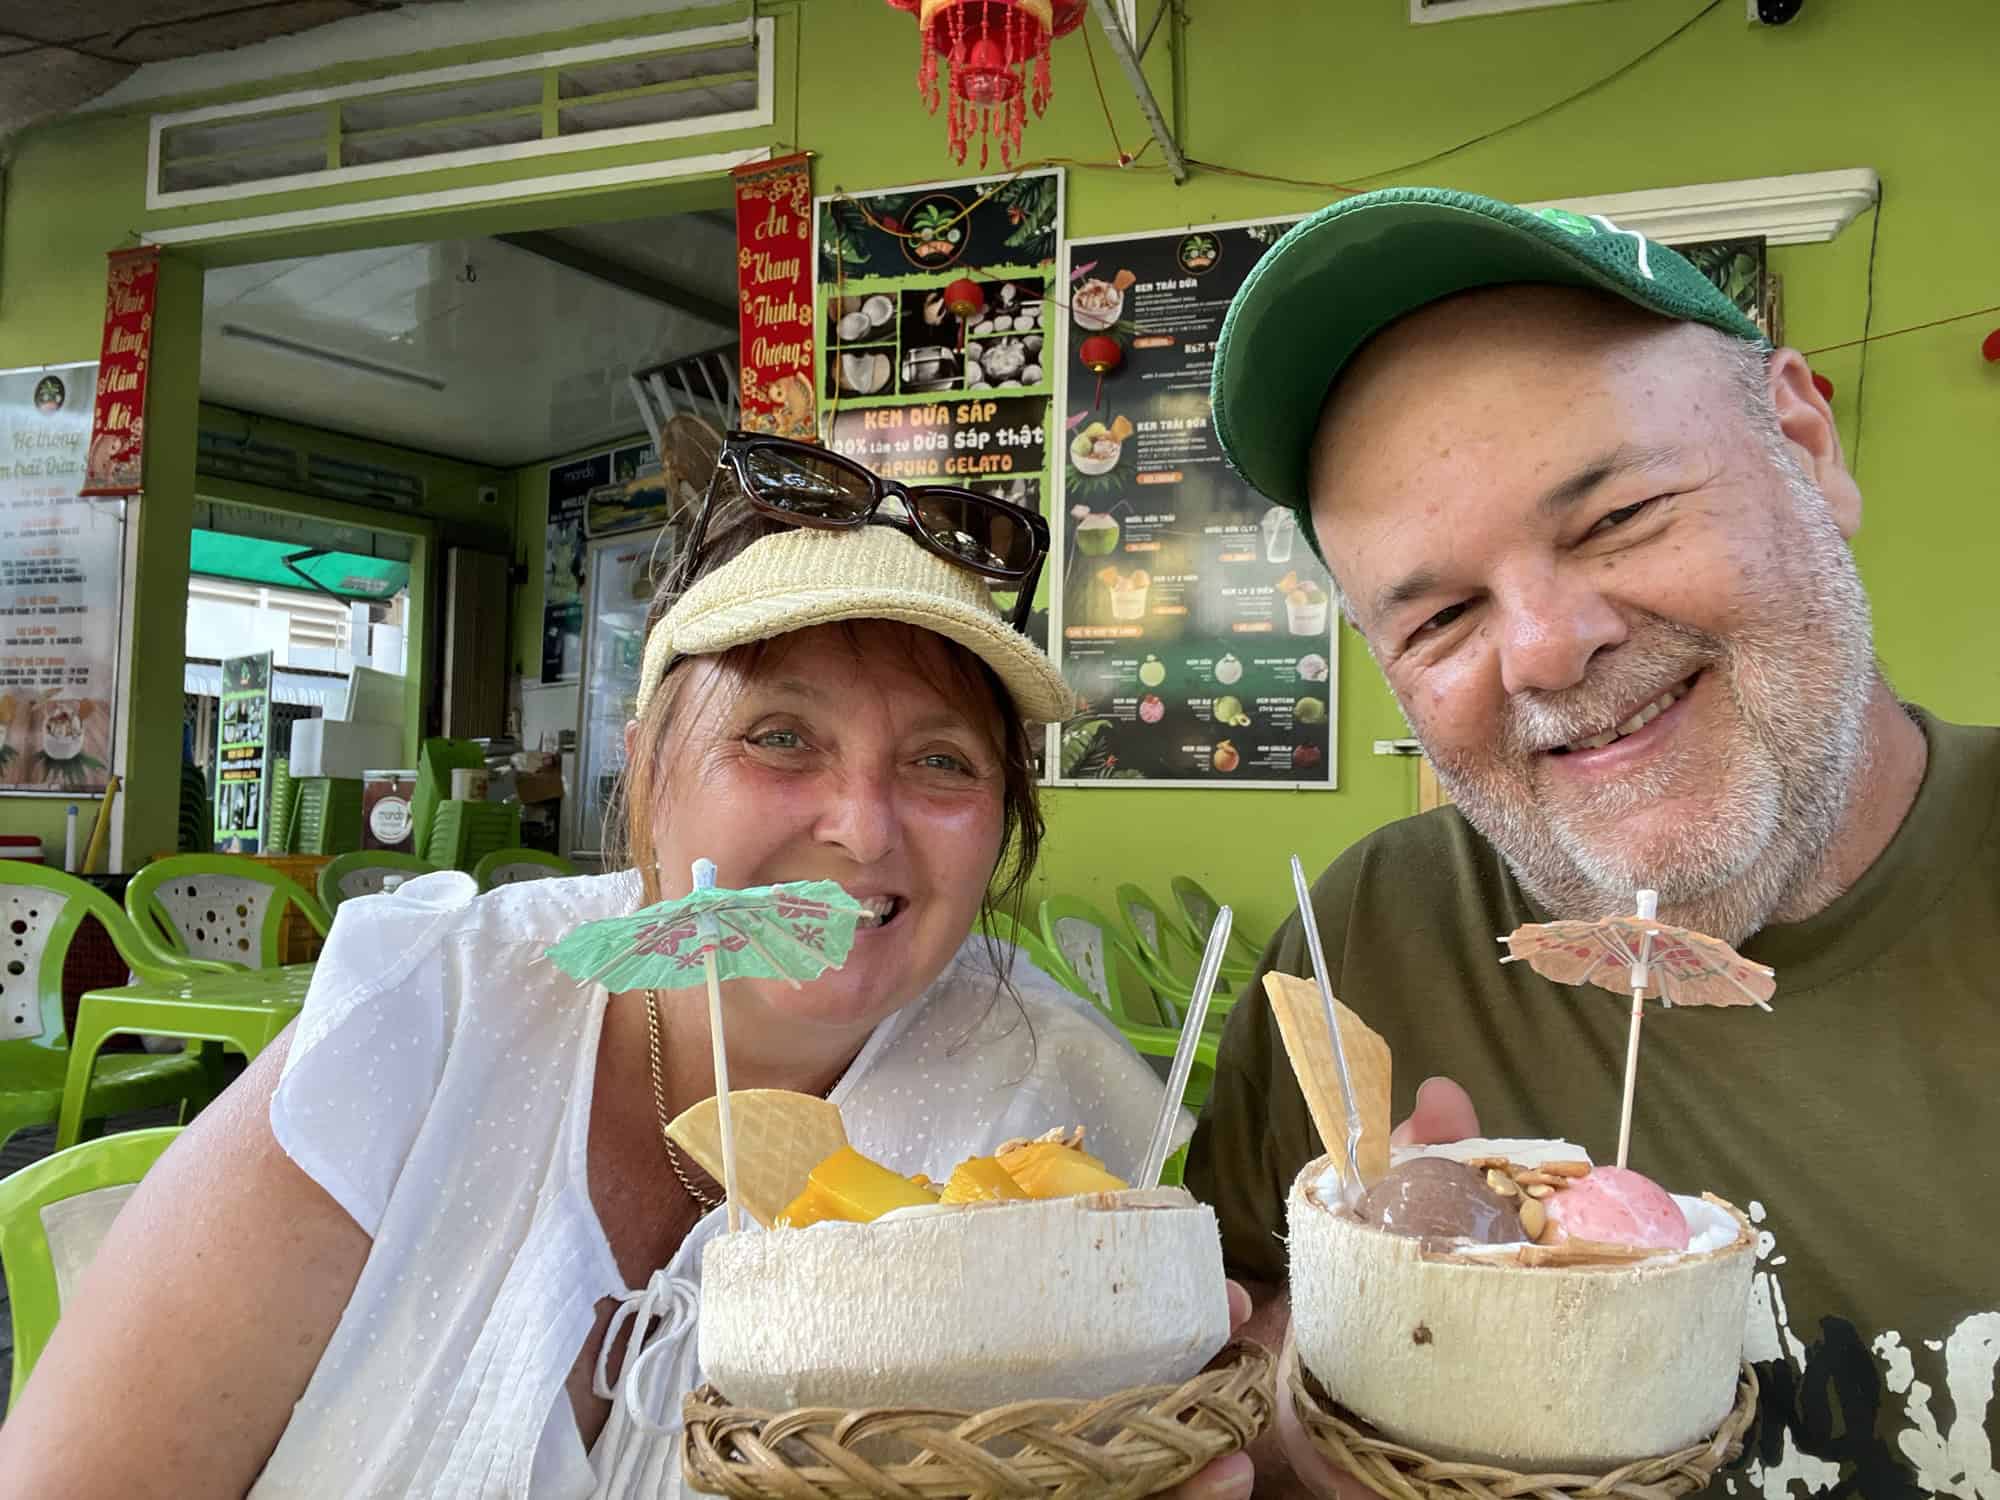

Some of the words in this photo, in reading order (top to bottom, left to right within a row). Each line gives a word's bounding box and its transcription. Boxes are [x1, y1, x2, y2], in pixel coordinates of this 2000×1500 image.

[754, 203, 789, 240] An
[751, 251, 800, 285] Khang
[753, 290, 797, 331] Thịnh
[752, 336, 801, 373] Vượng
[863, 408, 903, 431] KEM
[910, 402, 950, 427] DỪA
[956, 400, 998, 424] SÁP
[995, 424, 1044, 449] thật
[870, 457, 939, 478] CAPUNO
[944, 454, 1013, 475] GELATO
